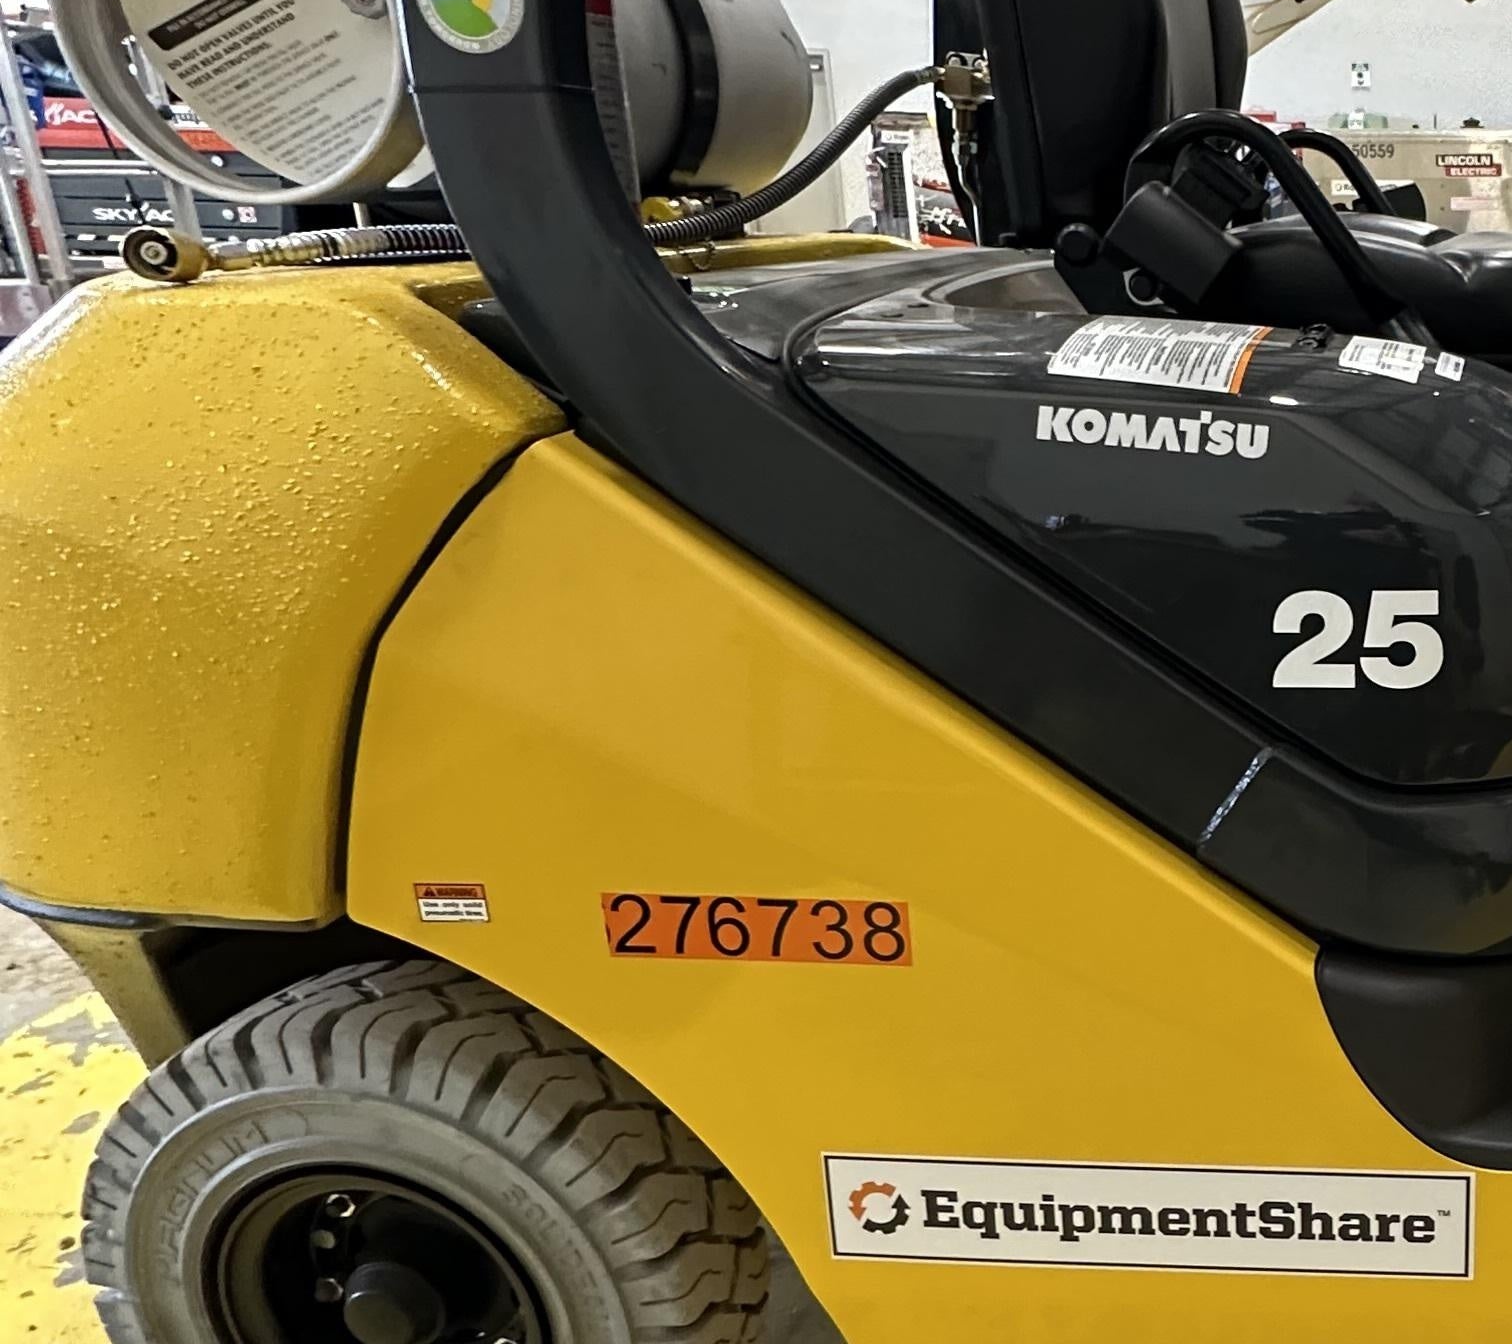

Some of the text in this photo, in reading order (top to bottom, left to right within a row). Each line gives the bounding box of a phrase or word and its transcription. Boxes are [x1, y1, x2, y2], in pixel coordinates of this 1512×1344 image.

[167, 58, 183, 71] DO
[181, 48, 201, 62] NOT
[199, 36, 223, 53] OPEN
[221, 20, 254, 41] VALVES
[252, 8, 279, 25] UNTIL
[176, 12, 296, 80] HAVE READ AND UNDERSTAND
[185, 72, 214, 89] THESE
[1437, 156, 1492, 166] LINCOLN
[1450, 167, 1498, 176] ELECTRIC
[1035, 405, 1270, 459] KOMATSU
[1272, 589, 1444, 689] 25
[435, 887, 478, 897] WARNING
[609, 894, 906, 962] 276738
[921, 1188, 1436, 1244] EquipmentShare
